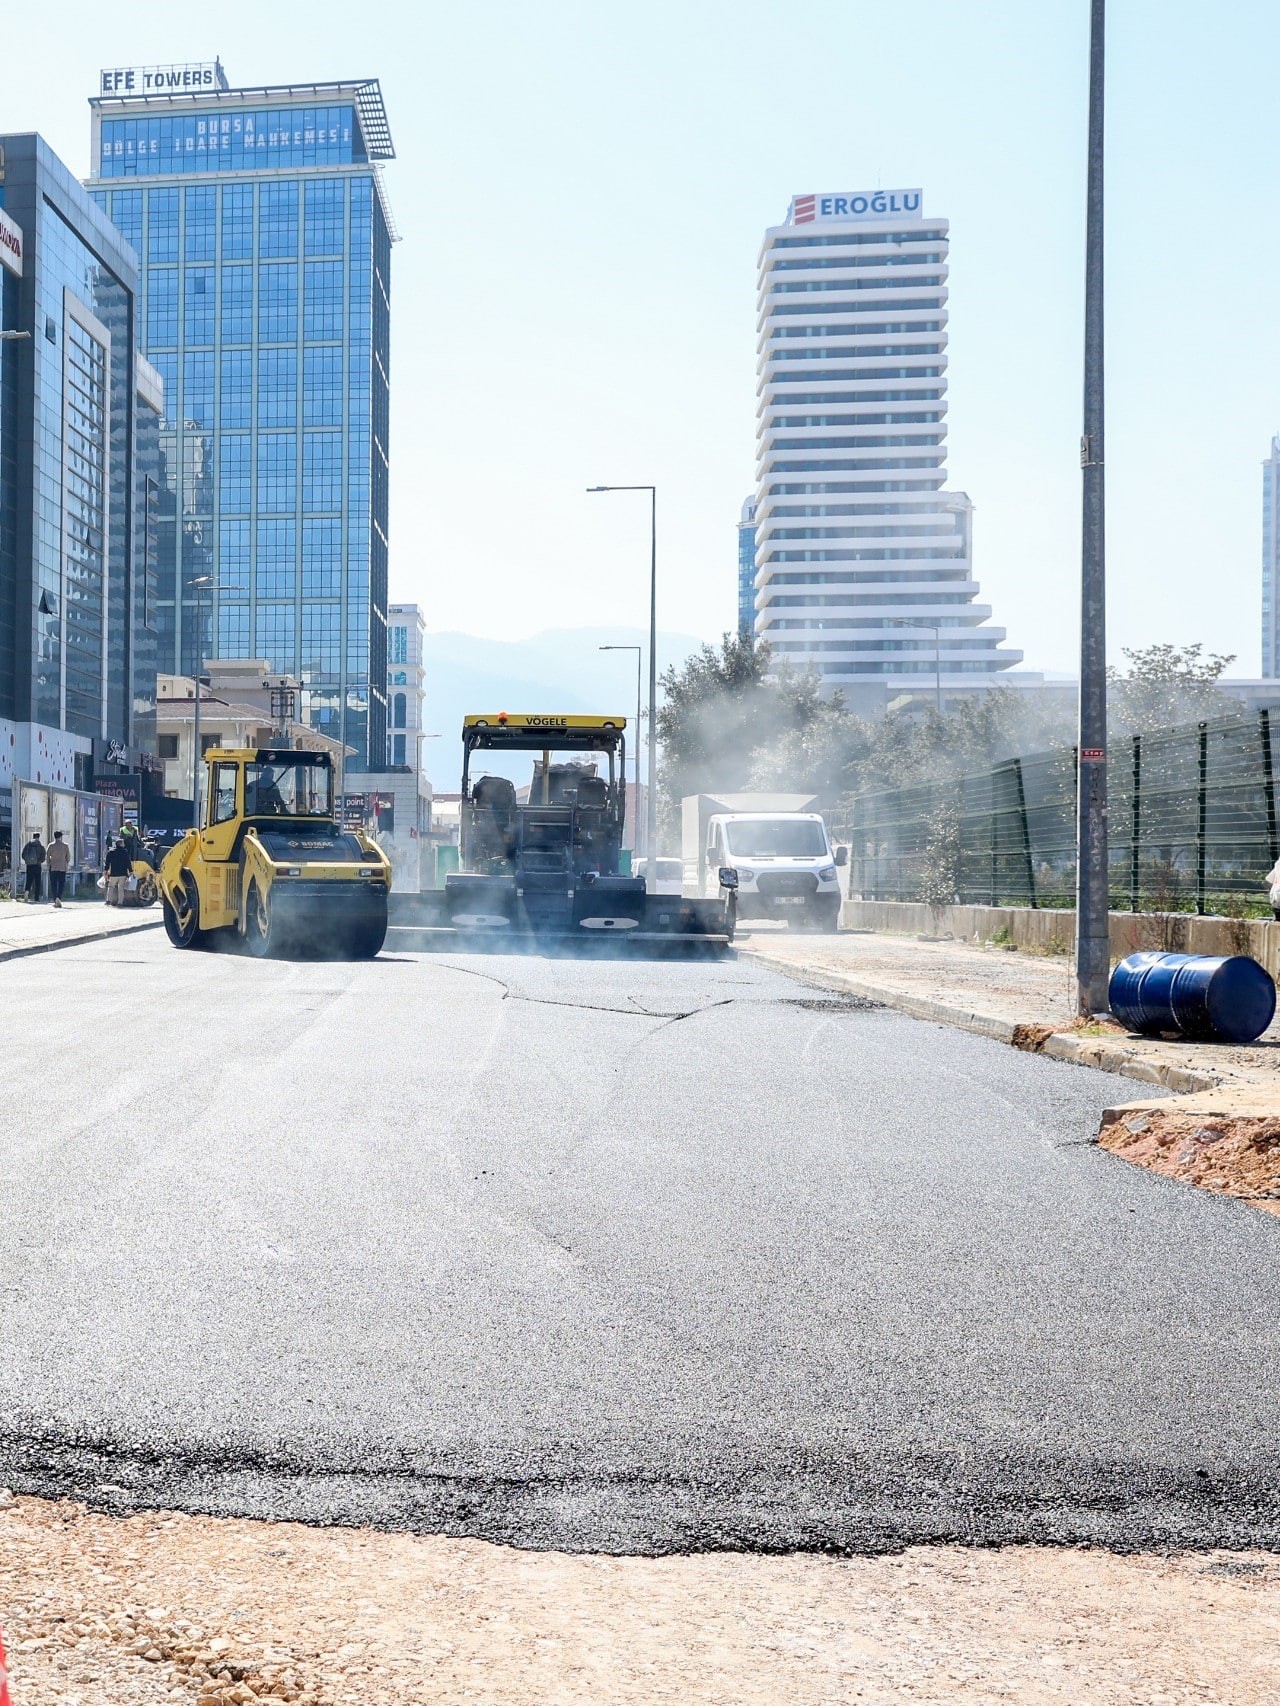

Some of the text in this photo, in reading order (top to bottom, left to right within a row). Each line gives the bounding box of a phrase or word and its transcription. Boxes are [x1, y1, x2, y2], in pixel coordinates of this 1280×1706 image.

[103, 70, 212, 91] EFE TOWERS
[198, 118, 254, 134] BURSA
[103, 128, 349, 156] BÖLGE İDARE MAHKEMESİ
[821, 191, 919, 215] EROĞLU
[526, 715, 567, 725] VÖGELE
